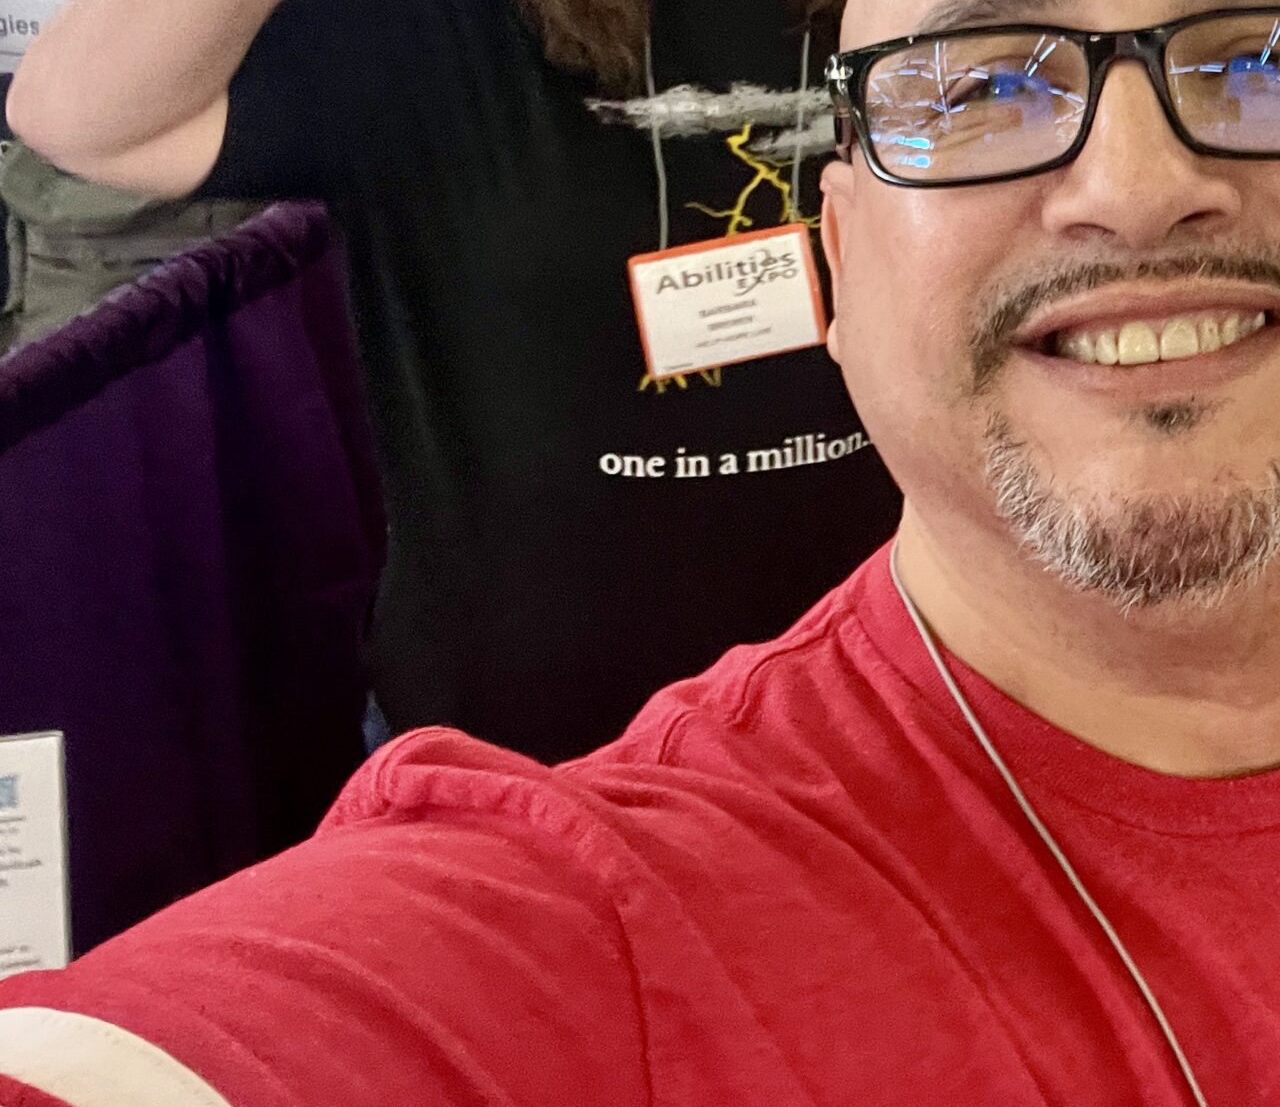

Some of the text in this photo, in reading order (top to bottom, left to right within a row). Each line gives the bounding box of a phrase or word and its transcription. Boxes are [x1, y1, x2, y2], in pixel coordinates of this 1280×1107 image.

[656, 250, 797, 294] Abilities
[599, 453, 666, 477] one
[674, 447, 711, 478] in
[718, 452, 740, 476] a
